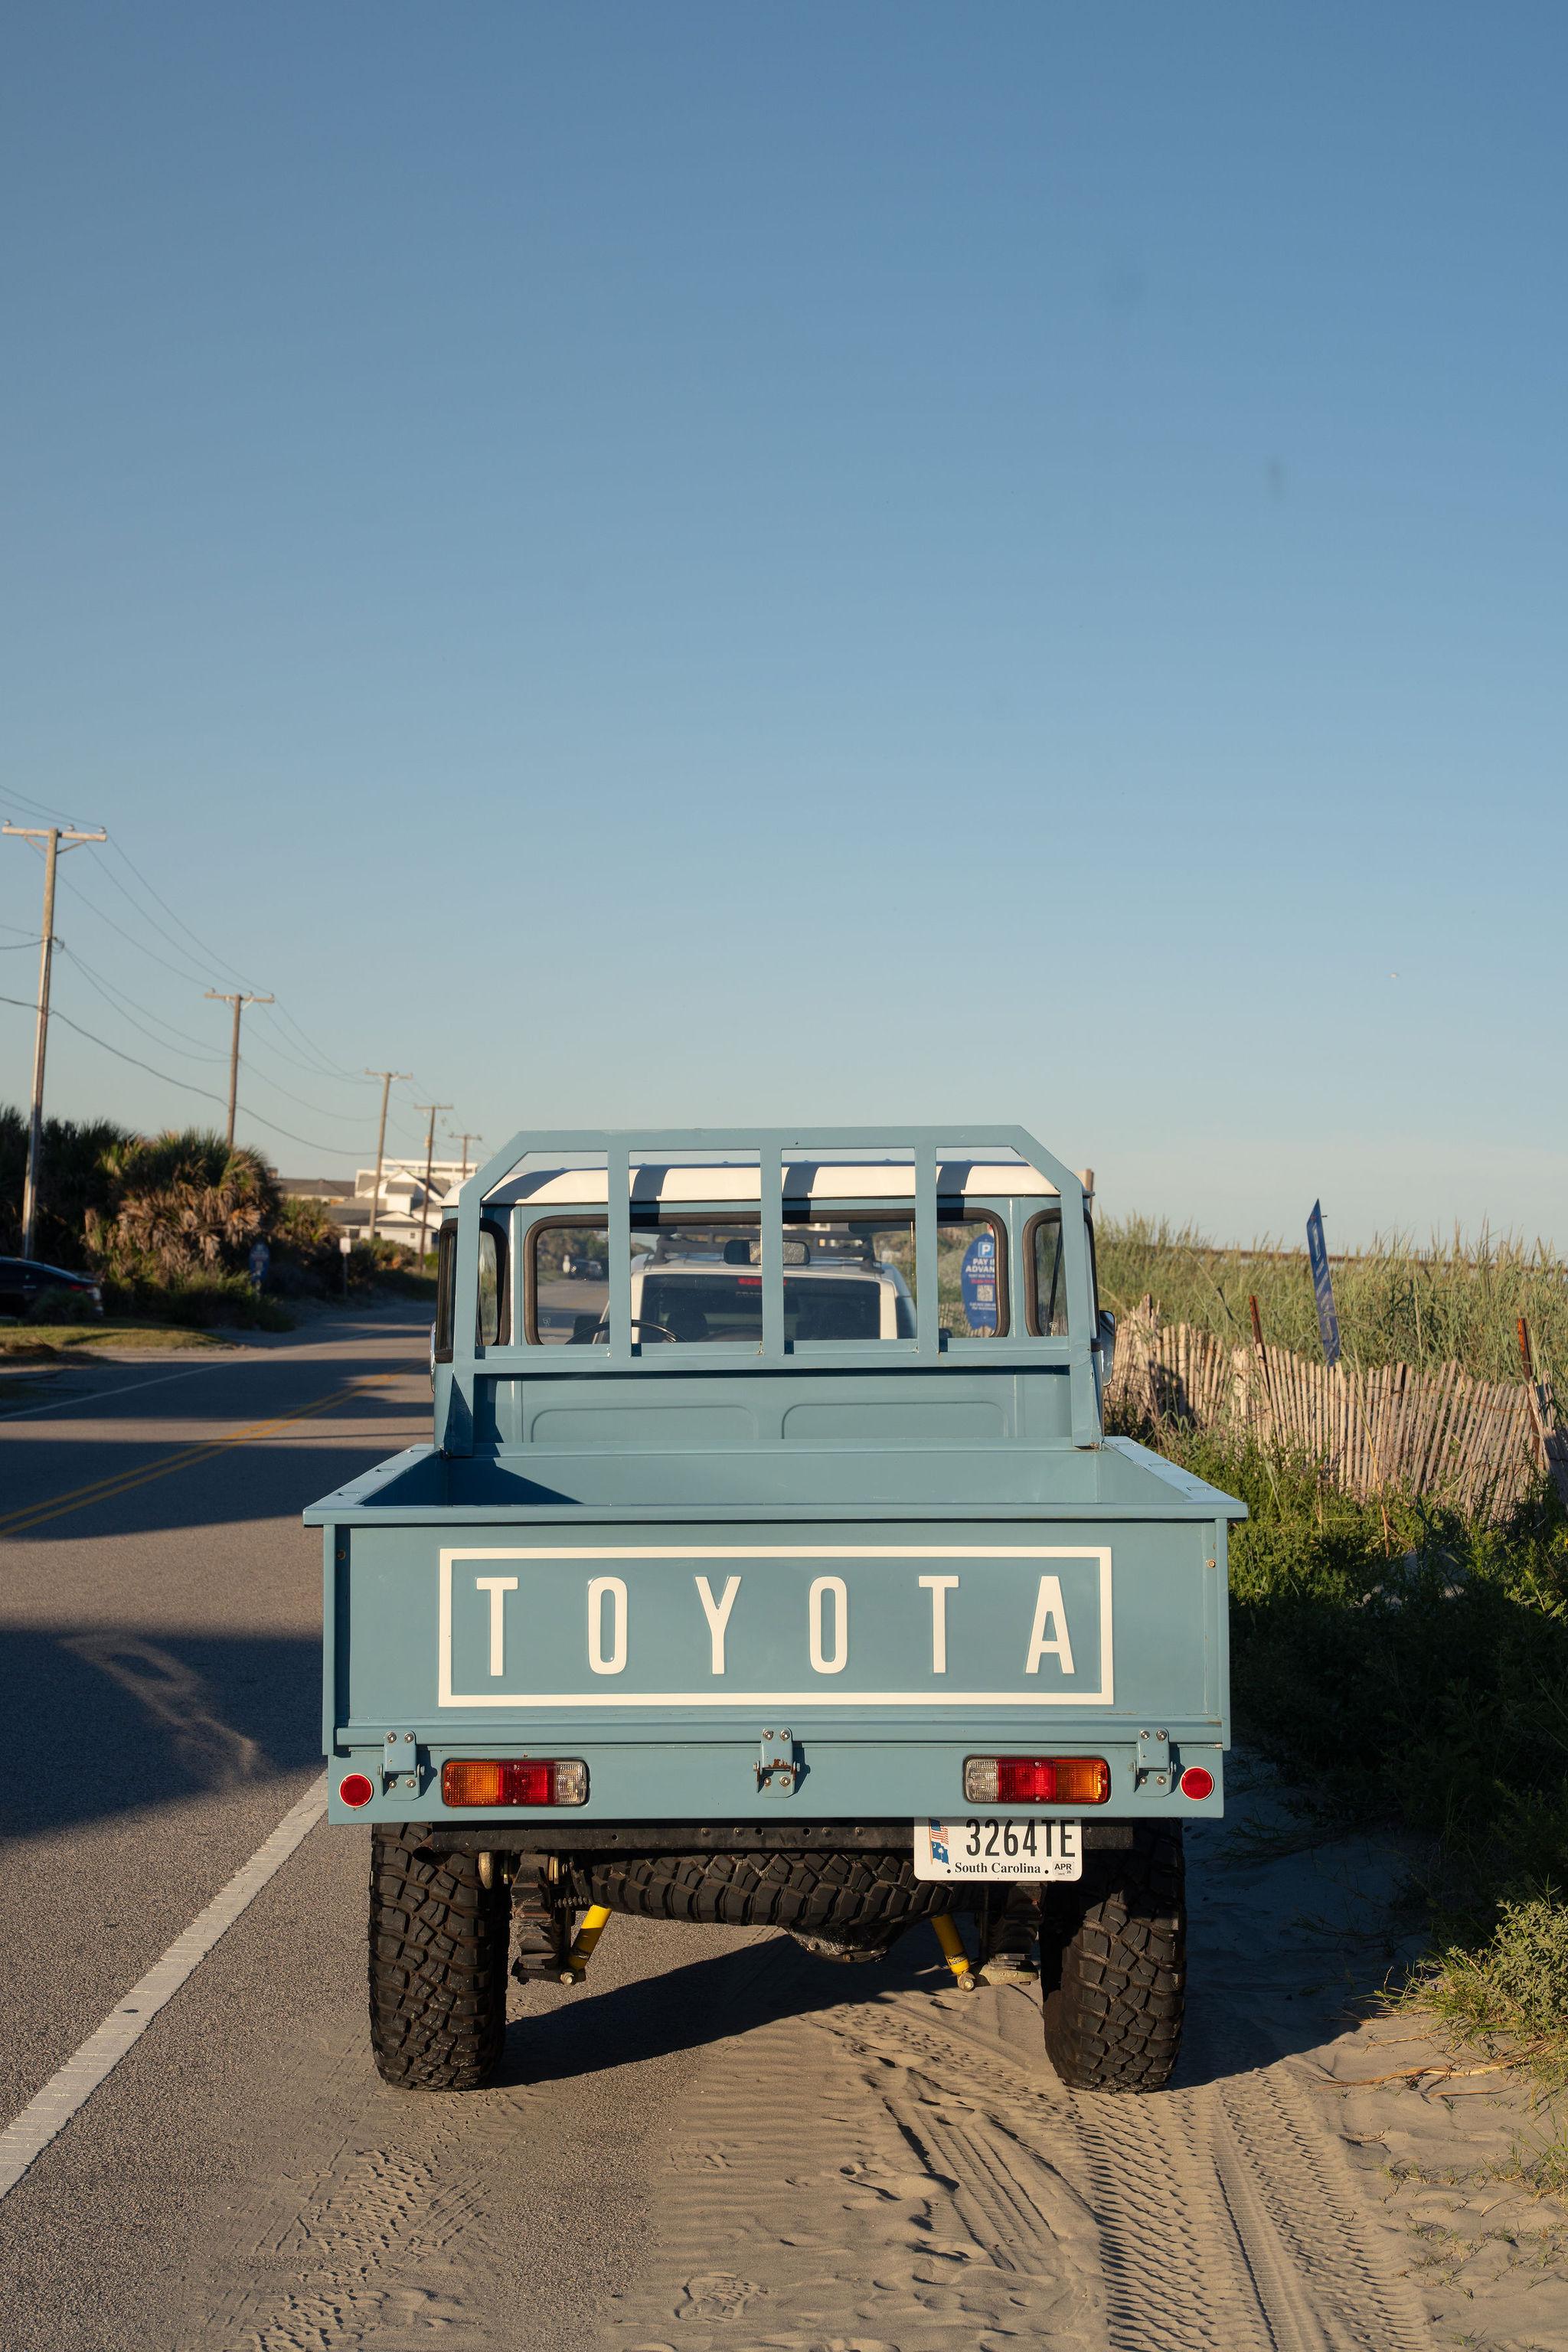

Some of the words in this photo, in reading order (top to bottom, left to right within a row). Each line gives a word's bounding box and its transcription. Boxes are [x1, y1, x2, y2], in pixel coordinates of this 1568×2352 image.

[982, 1244, 991, 1256] P
[476, 1576, 1075, 1676] TOYOTA
[965, 1818, 1076, 1857] 3264TE
[955, 1861, 988, 1873] South
[991, 1862, 1041, 1873] Carolina
